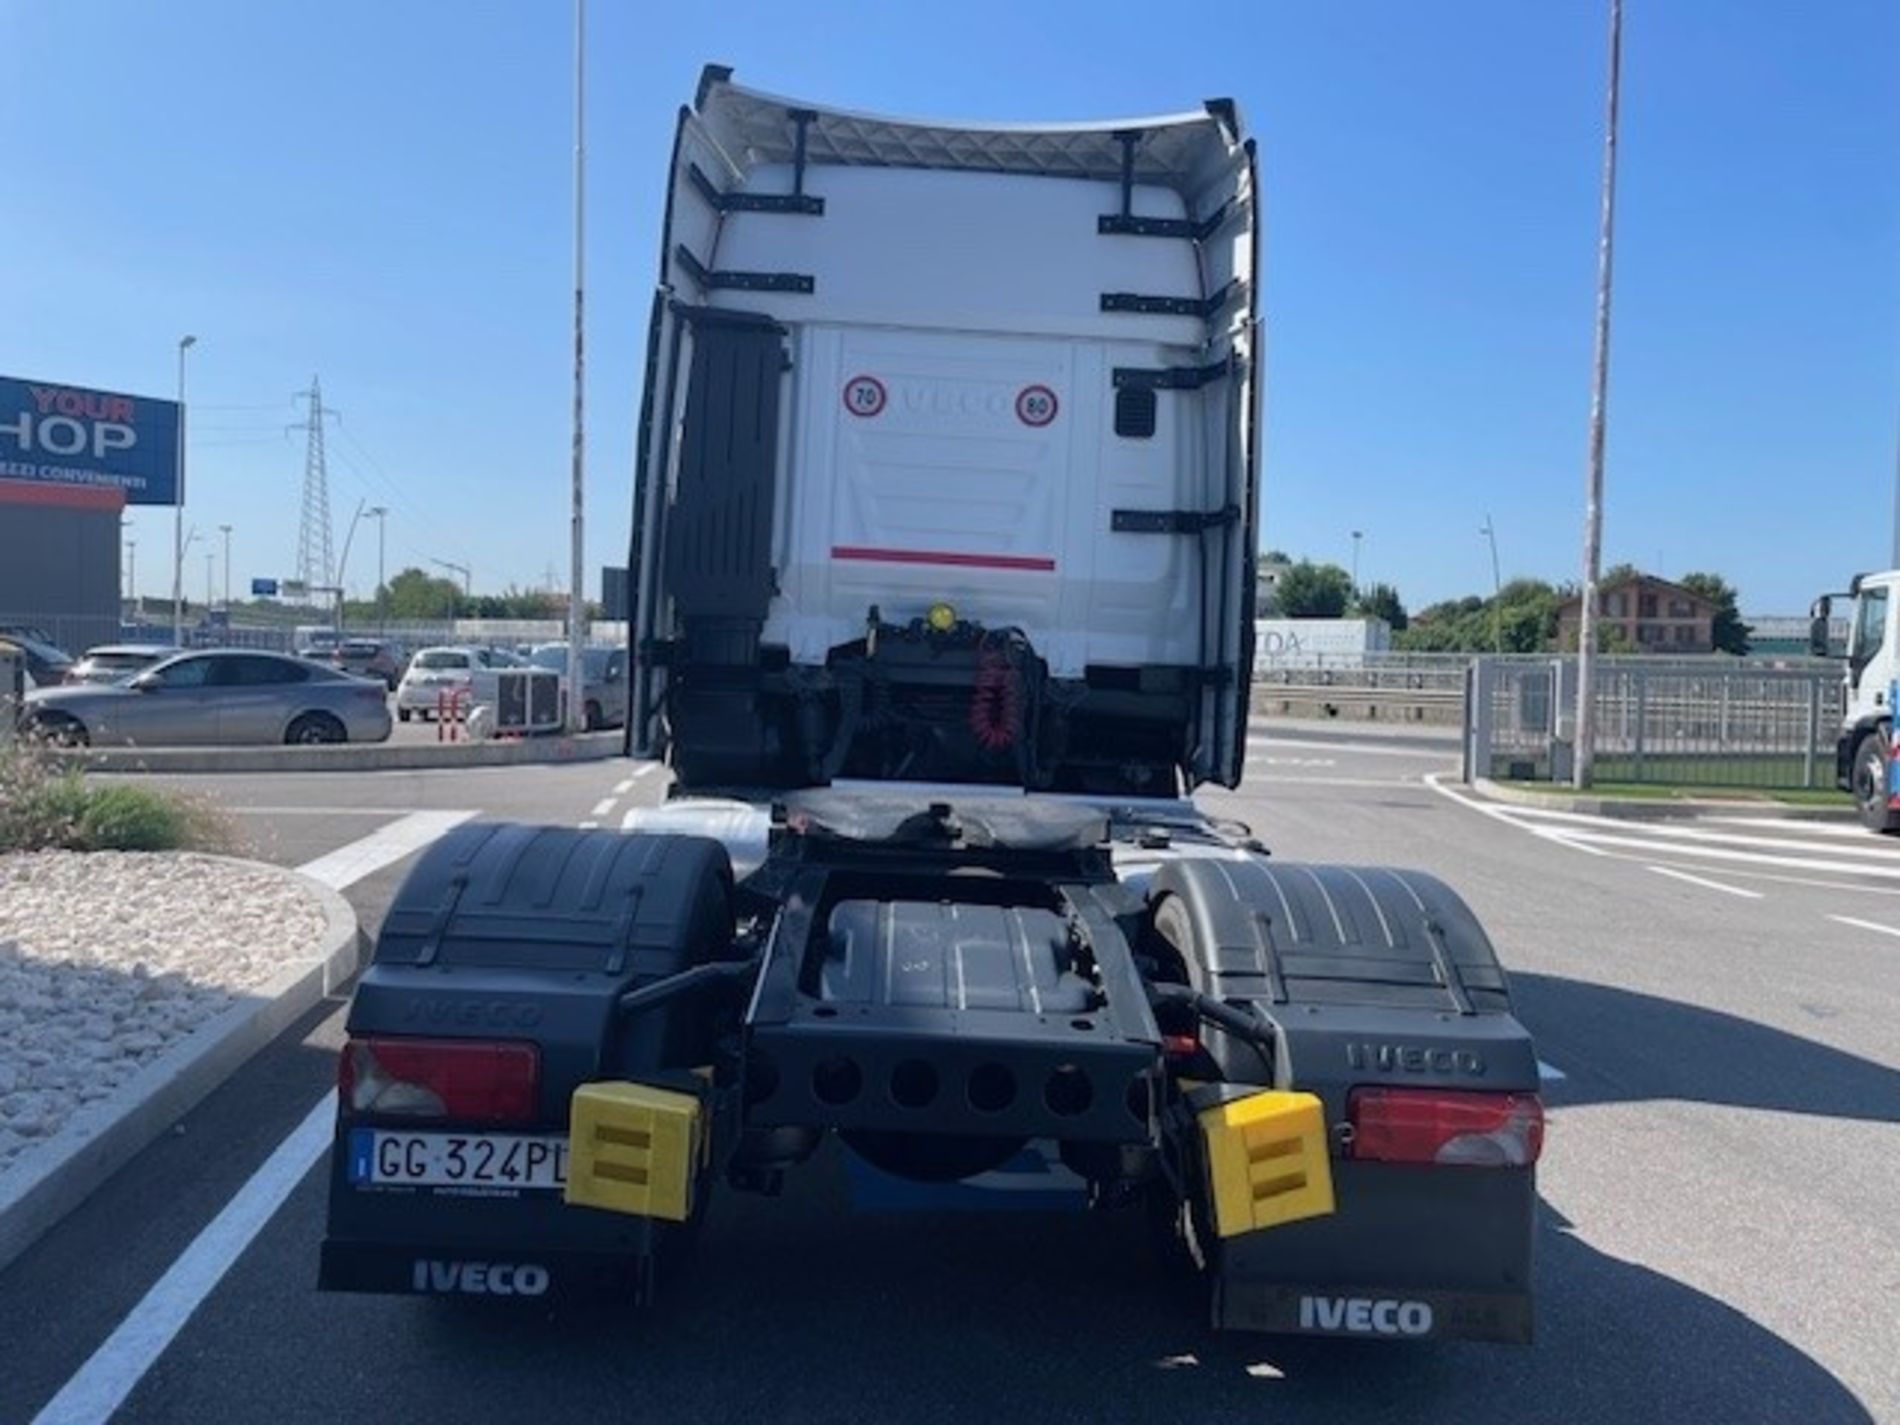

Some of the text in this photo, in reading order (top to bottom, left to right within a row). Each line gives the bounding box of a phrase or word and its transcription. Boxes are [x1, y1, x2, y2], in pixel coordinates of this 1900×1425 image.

[30, 386, 134, 422] YOUR
[855, 388, 876, 406] 70
[1026, 397, 1049, 415] 80
[0, 412, 138, 458] HOP
[403, 997, 545, 1028] IVECO
[1348, 1044, 1487, 1077] IVECO
[379, 1138, 428, 1177] GG
[412, 1260, 549, 1294] IVECO
[1300, 1297, 1432, 1334] IVECO
